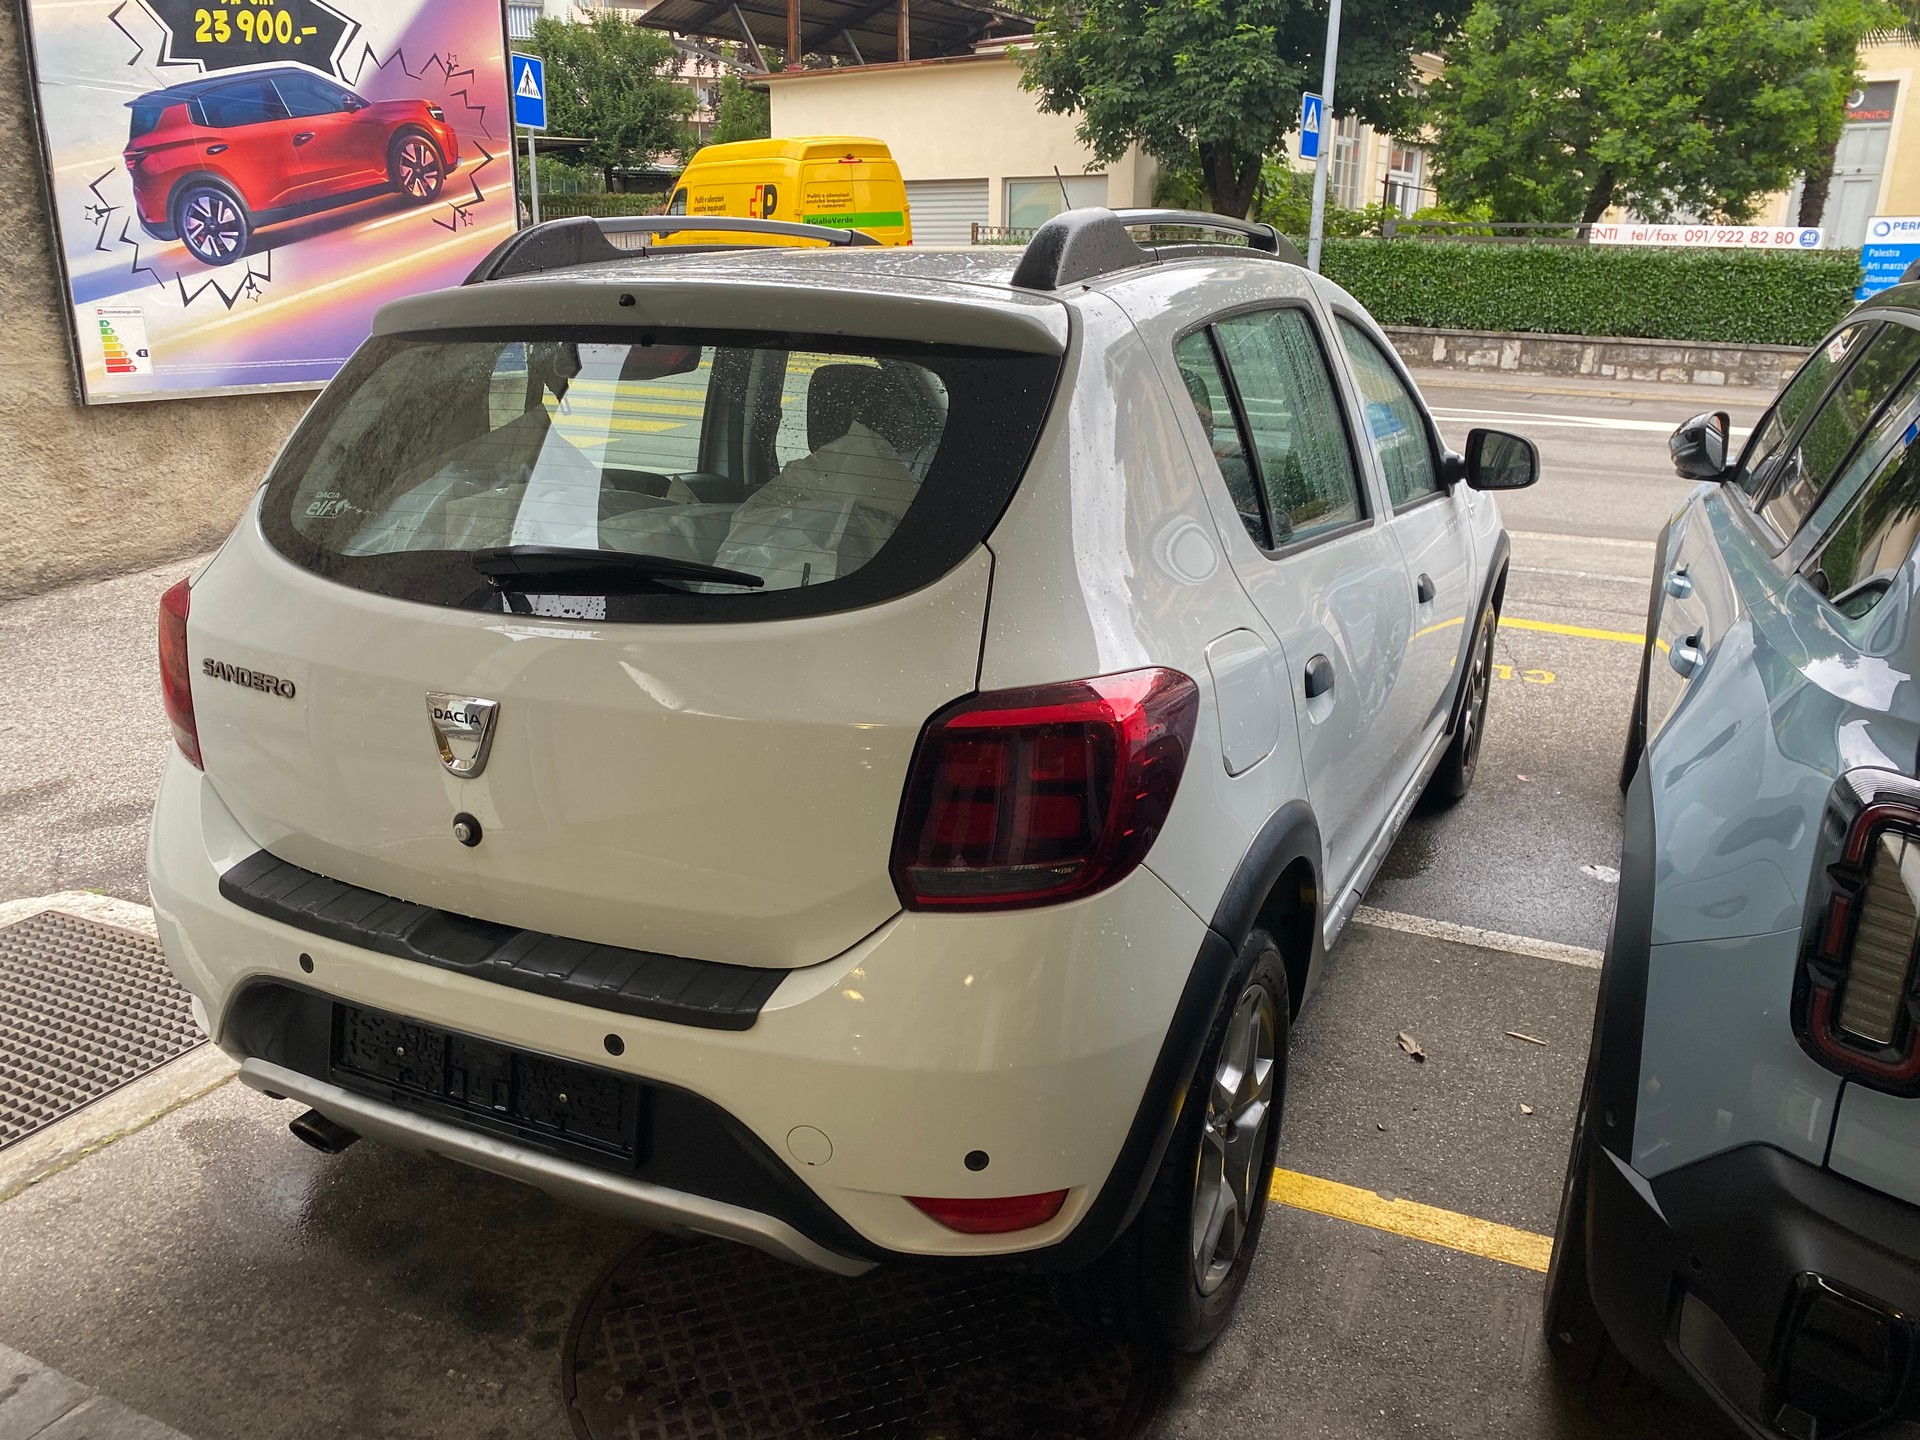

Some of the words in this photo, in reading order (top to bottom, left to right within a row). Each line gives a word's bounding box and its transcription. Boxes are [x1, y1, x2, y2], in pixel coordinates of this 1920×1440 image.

[195, 9, 231, 43] 23
[236, 9, 317, 45] 900.-
[806, 216, 854, 225] #GialloVerde
[1589, 227, 1618, 241] ENTI
[1631, 228, 1678, 242] tel/fax
[1684, 229, 1744, 243] 091/922
[1750, 230, 1769, 244] 82
[1775, 231, 1795, 245] 80
[1803, 233, 1816, 241] 40
[1869, 249, 1900, 258] Palestra
[1867, 262, 1880, 270] Arti
[1865, 275, 1899, 283] Allename
[316, 491, 341, 499] DACIA
[305, 500, 336, 516] elf
[202, 657, 296, 699] SANDERO
[433, 708, 481, 726] DACIA
